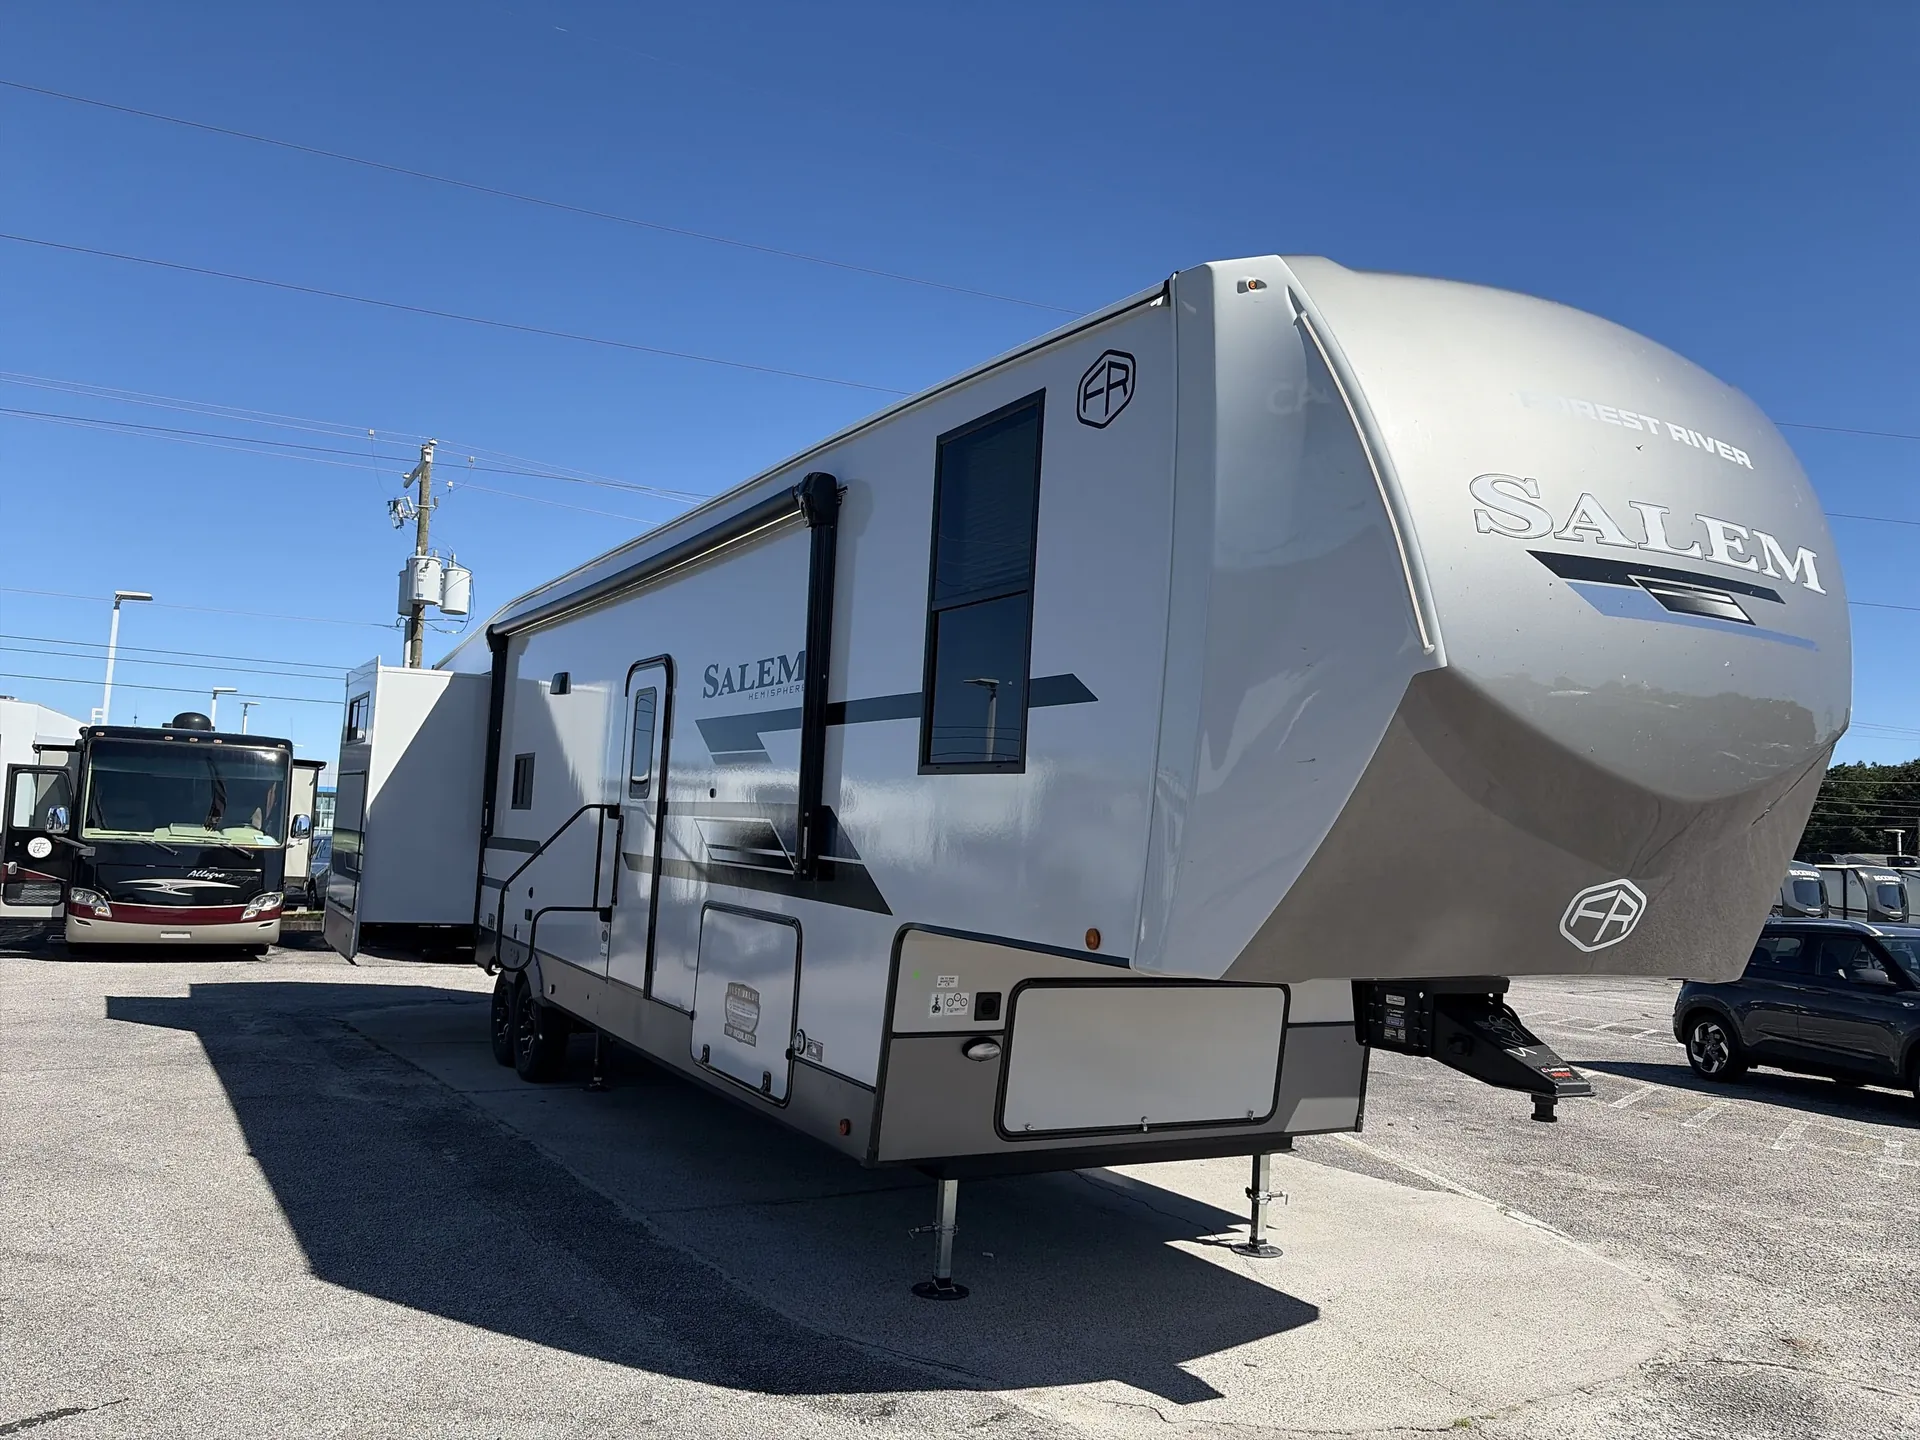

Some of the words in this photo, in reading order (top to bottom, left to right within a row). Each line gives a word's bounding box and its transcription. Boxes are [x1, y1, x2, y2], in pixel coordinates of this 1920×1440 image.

[1517, 389, 1660, 435] REST
[1666, 421, 1754, 470] RIVER
[1469, 473, 1828, 596] SALEM
[702, 650, 806, 699] SALEM
[186, 869, 226, 880] Allegro
